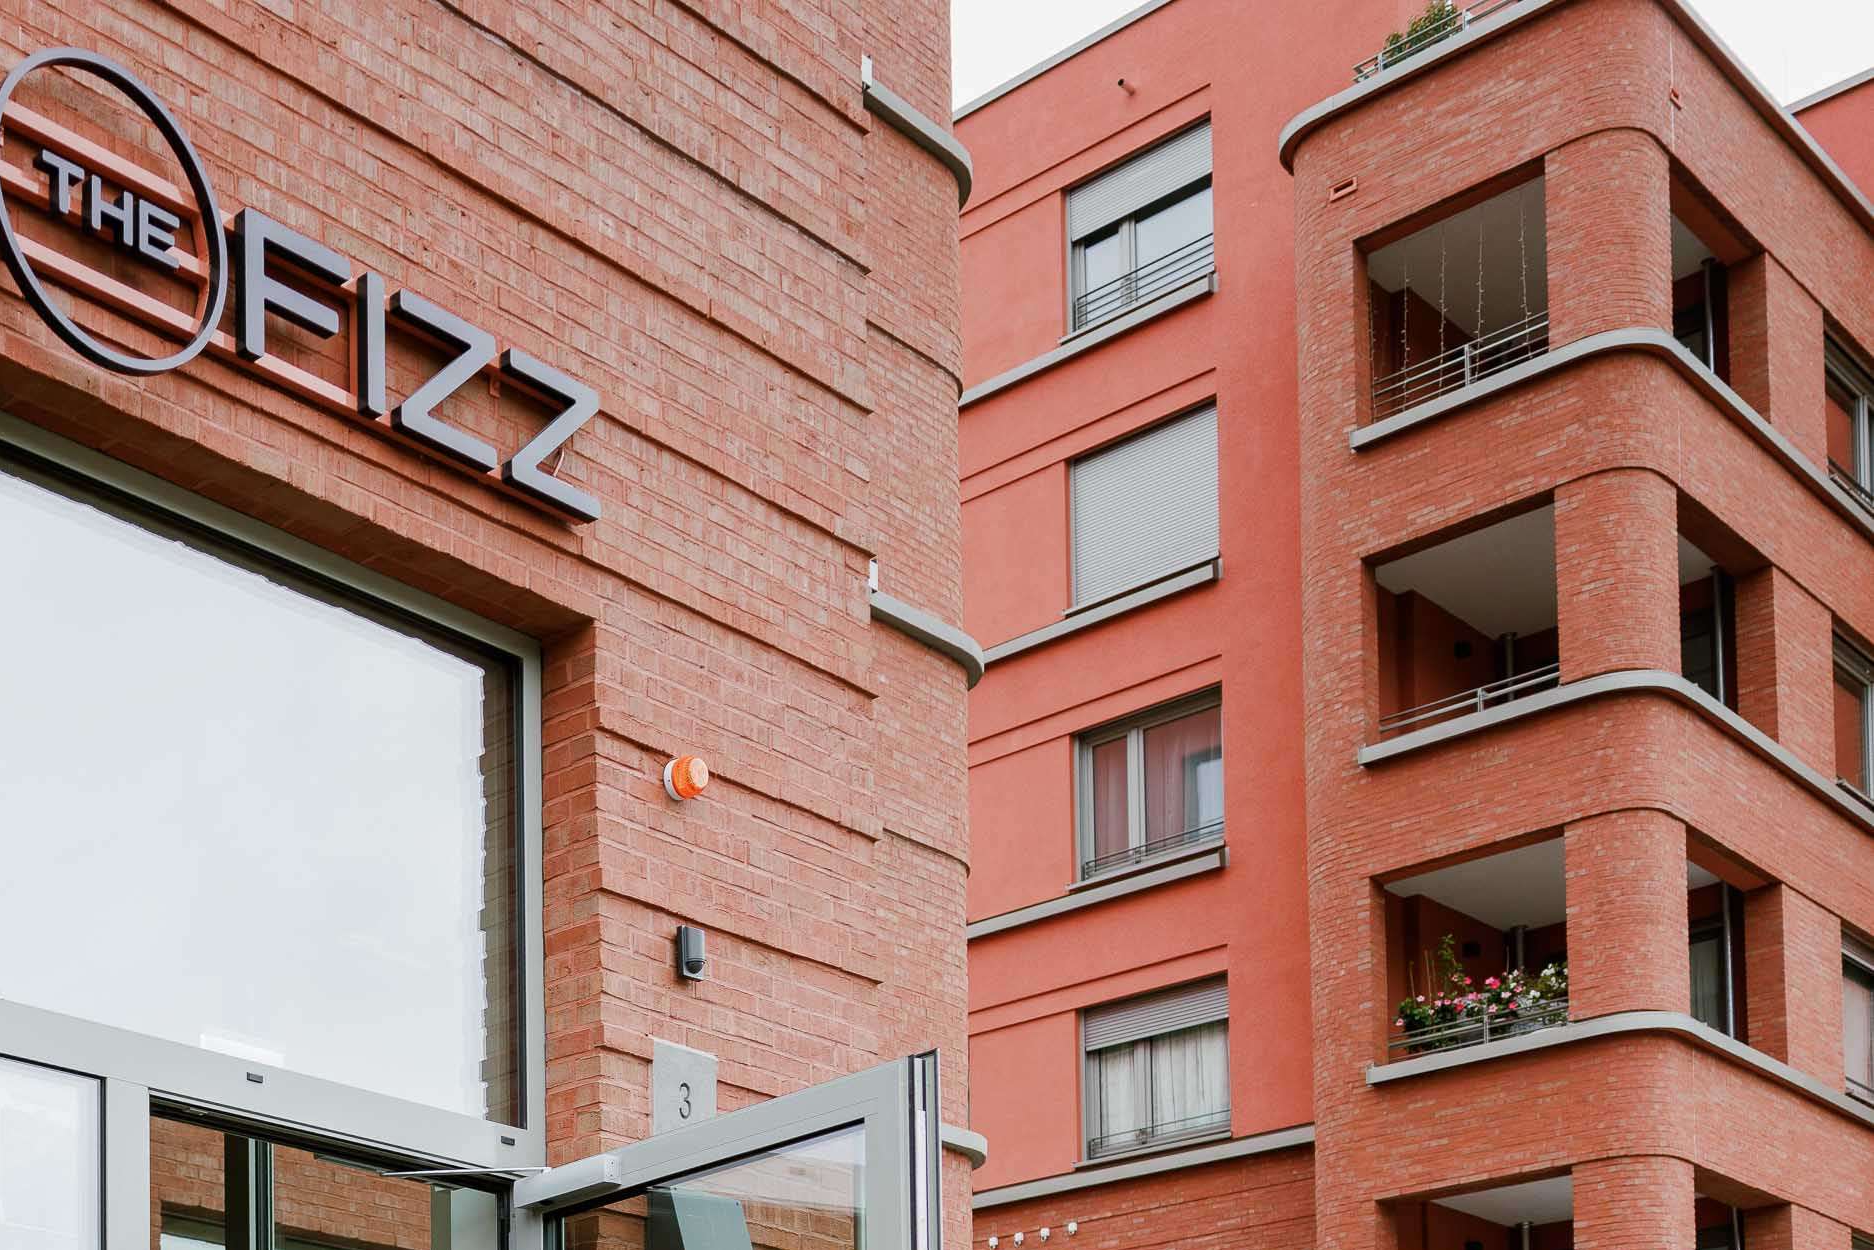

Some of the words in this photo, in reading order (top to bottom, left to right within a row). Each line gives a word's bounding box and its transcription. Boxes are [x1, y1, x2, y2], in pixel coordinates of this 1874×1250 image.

[35, 146, 182, 271] THE
[234, 206, 602, 524] FIZZ
[678, 1081, 692, 1120] 3
